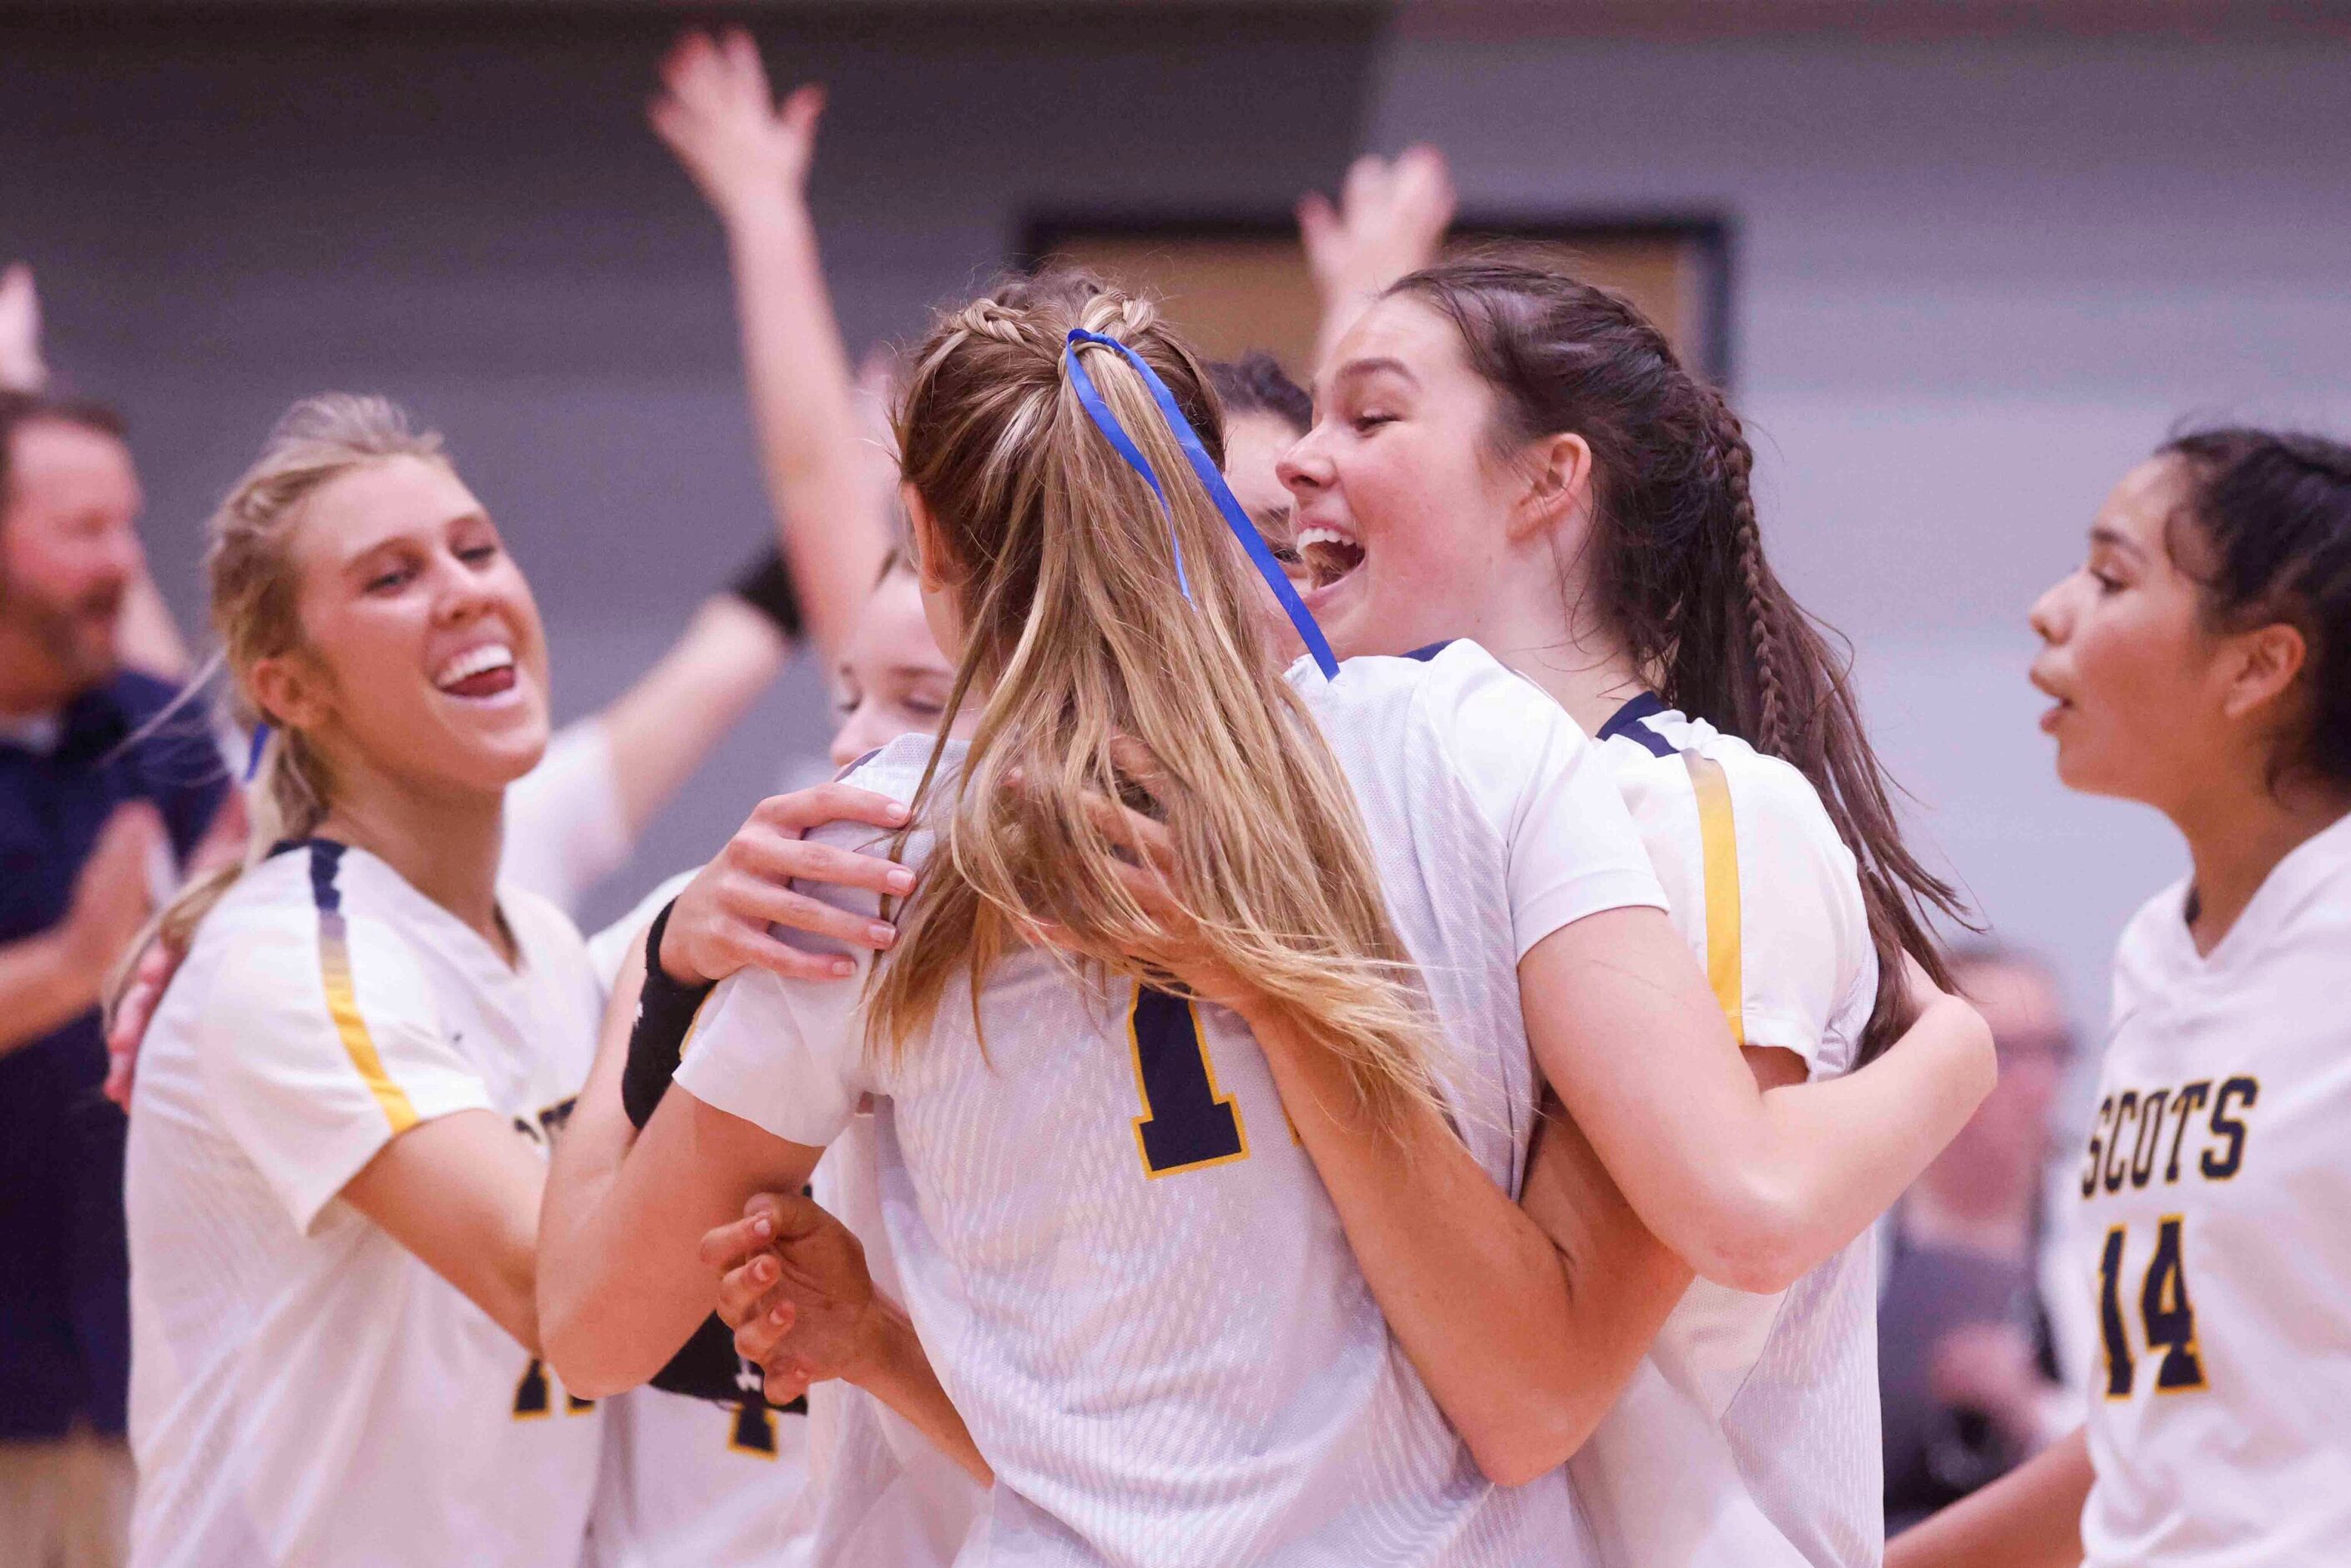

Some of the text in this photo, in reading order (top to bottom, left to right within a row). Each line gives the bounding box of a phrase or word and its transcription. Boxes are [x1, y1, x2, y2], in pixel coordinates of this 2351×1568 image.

[1119, 960, 1299, 1181] 1
[2081, 1075, 2259, 1200] SCOTS
[2098, 1214, 2209, 1400] 14
